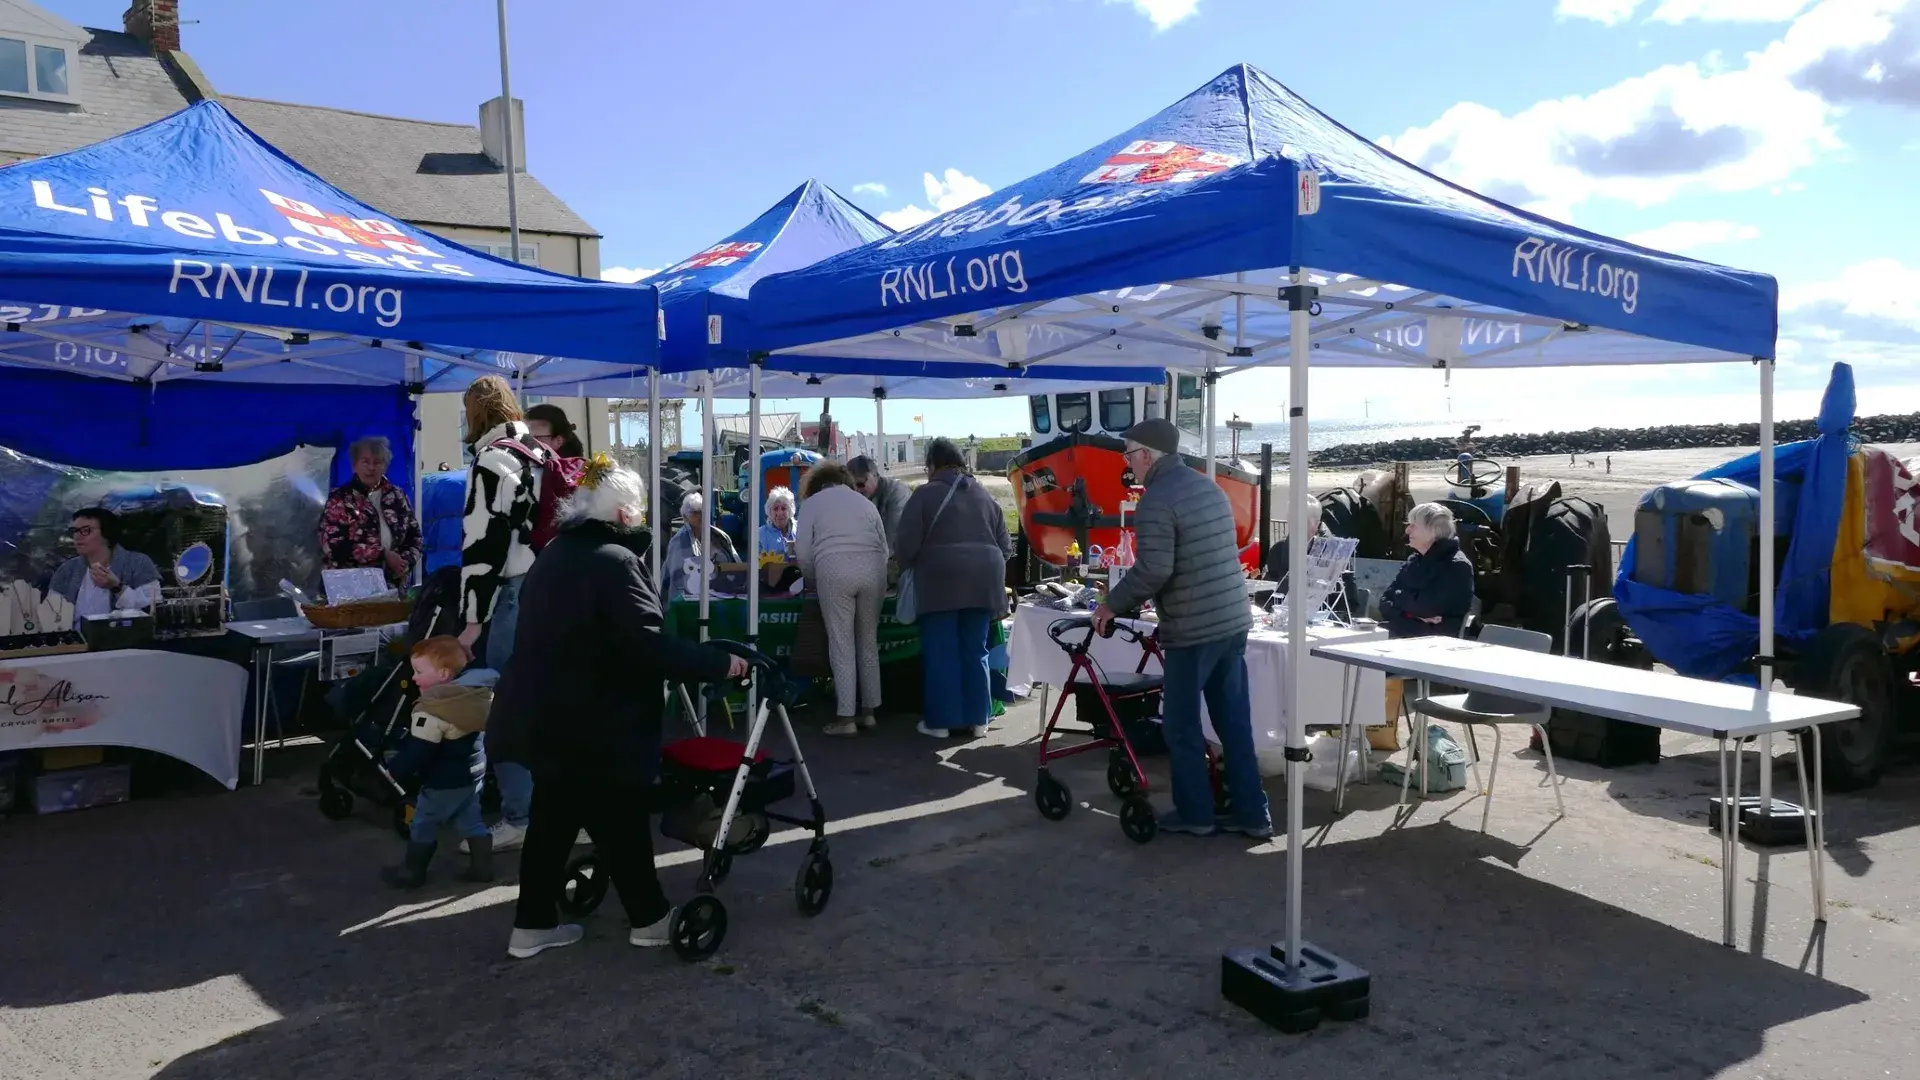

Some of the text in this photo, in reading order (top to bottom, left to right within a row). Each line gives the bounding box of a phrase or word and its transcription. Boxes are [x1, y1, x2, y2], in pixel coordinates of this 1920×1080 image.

[31, 180, 475, 276] Lifeboats
[169, 259, 402, 327] RNLI.org
[881, 250, 1028, 306] RNLI.org
[1512, 236, 1638, 314] RNLI.org
[1, 719, 37, 728] CRYLIC
[13, 680, 110, 716] Alison
